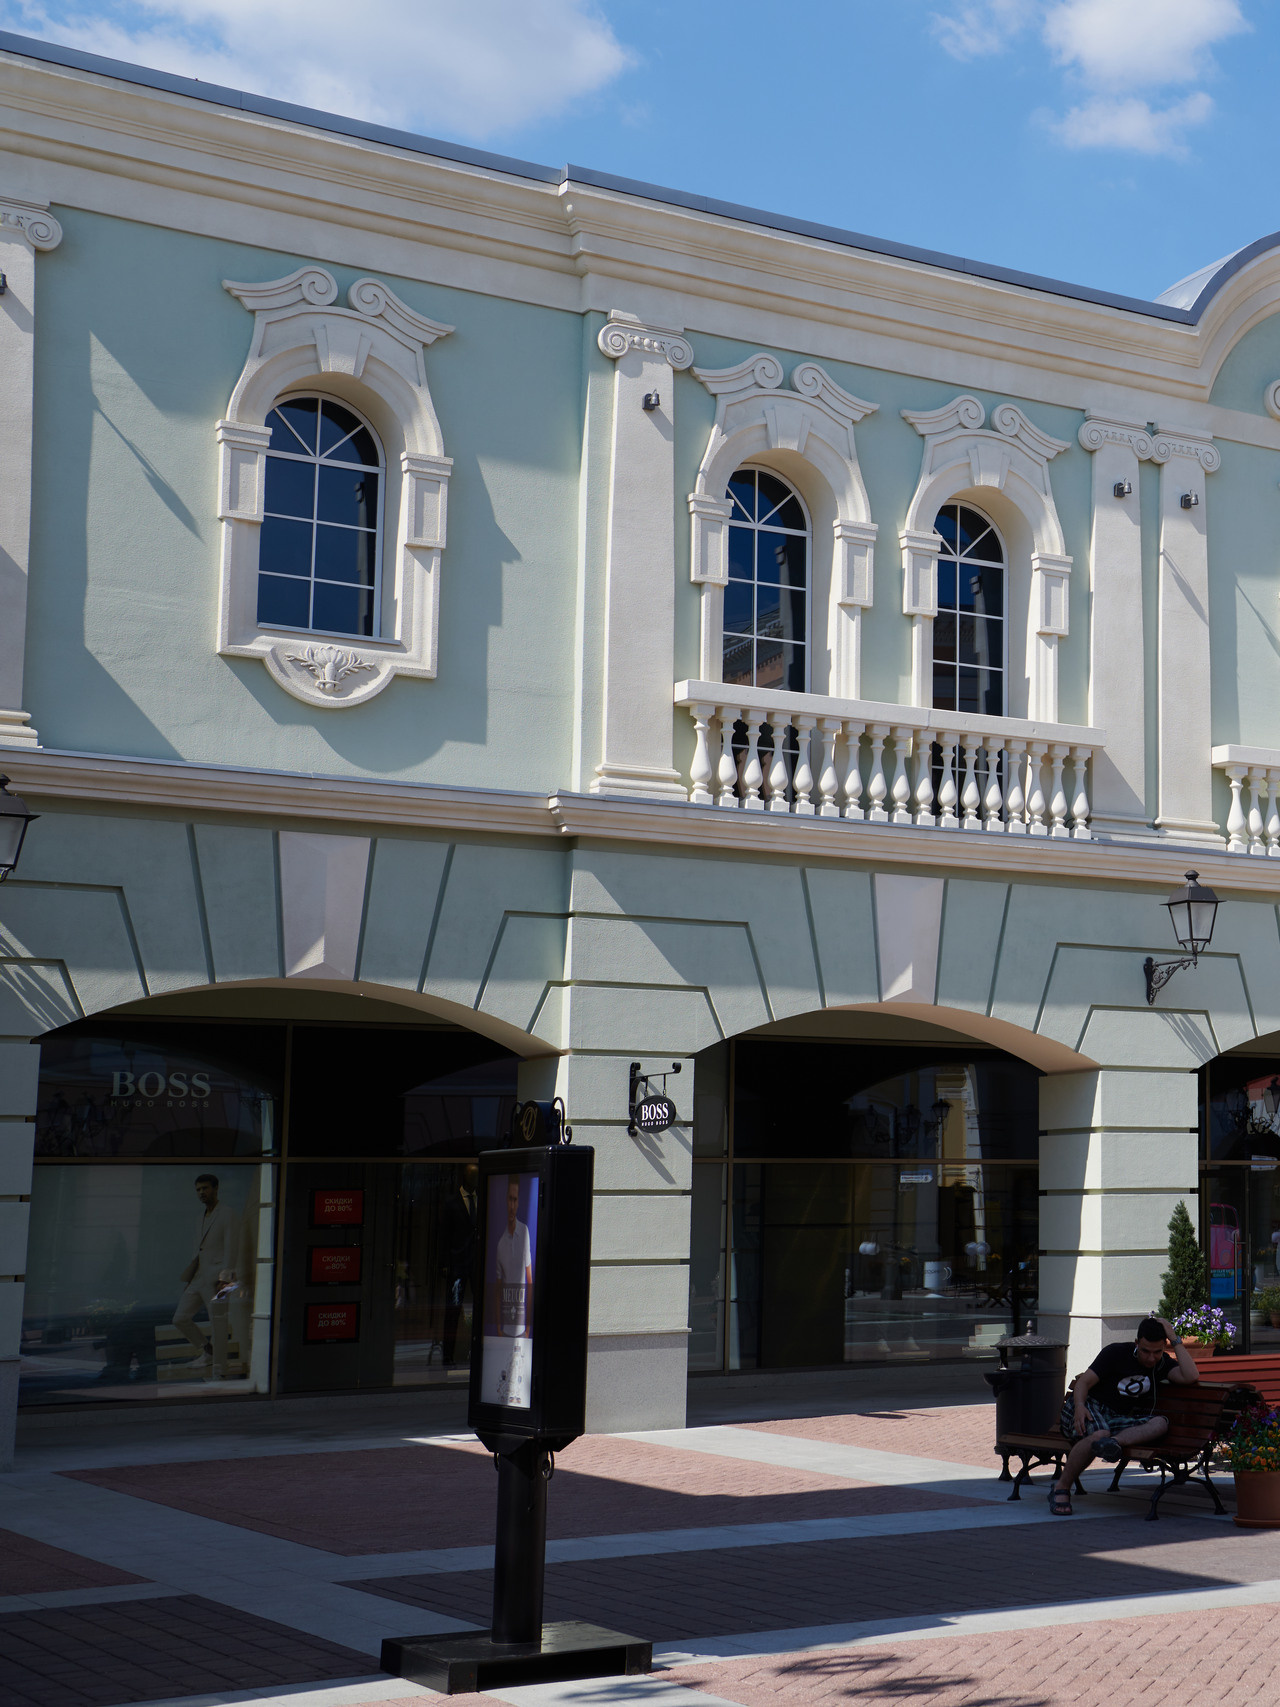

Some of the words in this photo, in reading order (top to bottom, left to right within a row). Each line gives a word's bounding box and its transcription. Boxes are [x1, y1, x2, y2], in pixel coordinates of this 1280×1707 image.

[110, 1071, 211, 1098] BOSS
[167, 1100, 209, 1108] BOSS
[641, 1102, 669, 1121] BOSS
[324, 1205, 336, 1213] ДО
[337, 1204, 353, 1212] 80%
[322, 1255, 350, 1263] СКИДКИ
[331, 1262, 347, 1270] 80%
[318, 1311, 346, 1319] СКИДКИ
[318, 1320, 330, 1328] ДО
[330, 1319, 347, 1327] 80%
